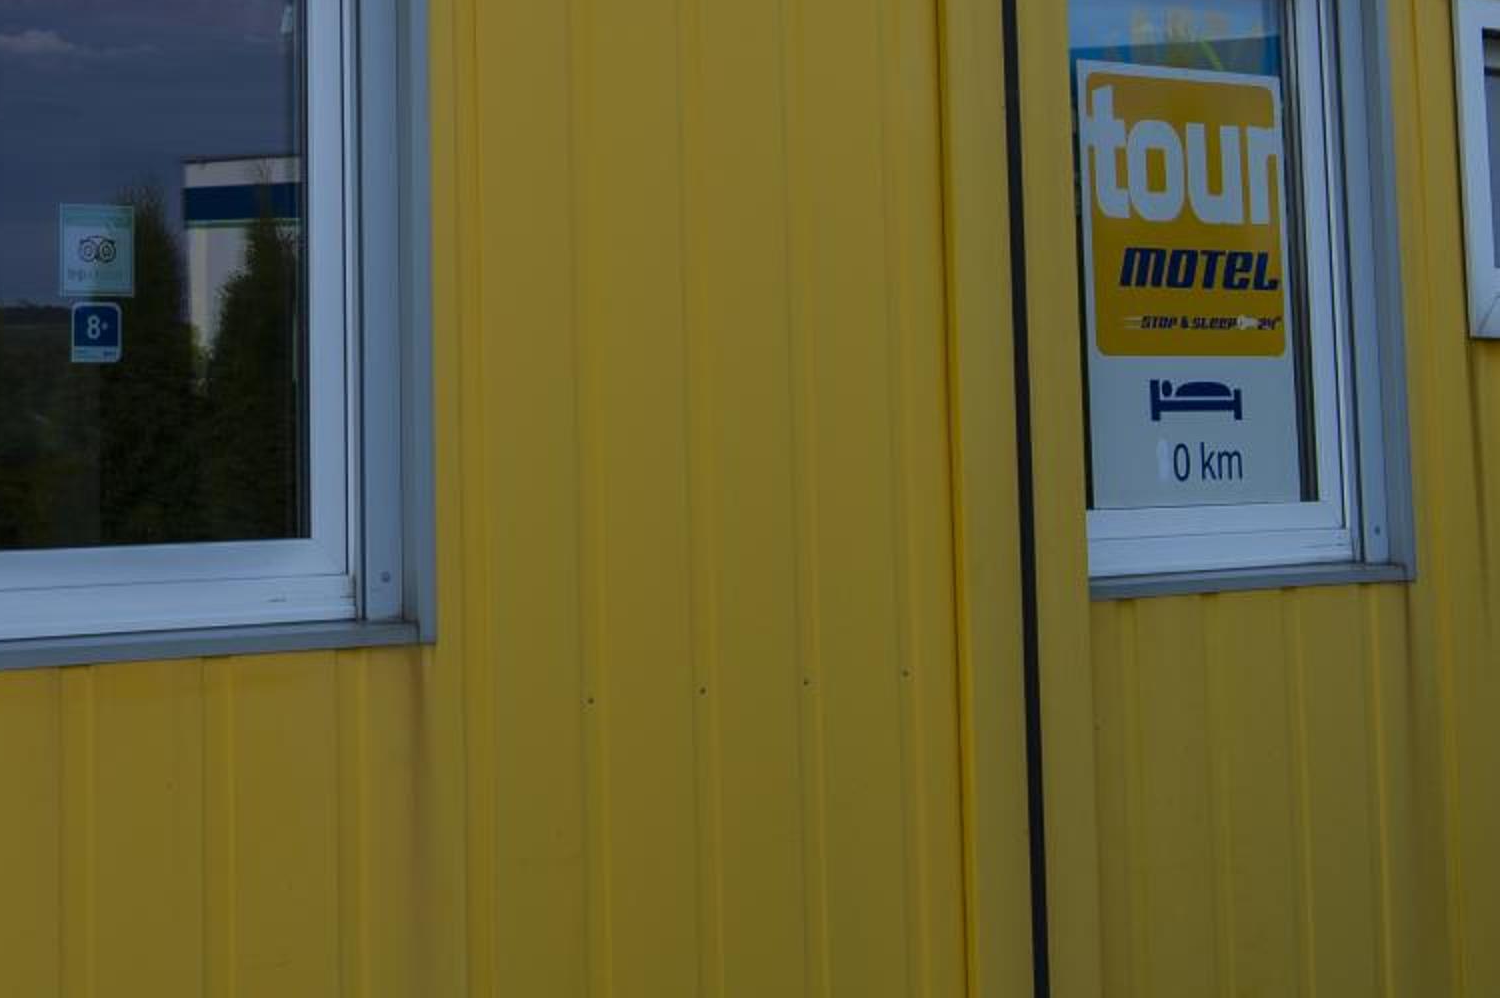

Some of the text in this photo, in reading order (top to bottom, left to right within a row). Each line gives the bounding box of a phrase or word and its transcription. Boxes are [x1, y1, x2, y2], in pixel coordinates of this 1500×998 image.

[1086, 85, 1278, 225] tour
[1119, 247, 1279, 291] MOTEL
[1200, 441, 1243, 480] km
